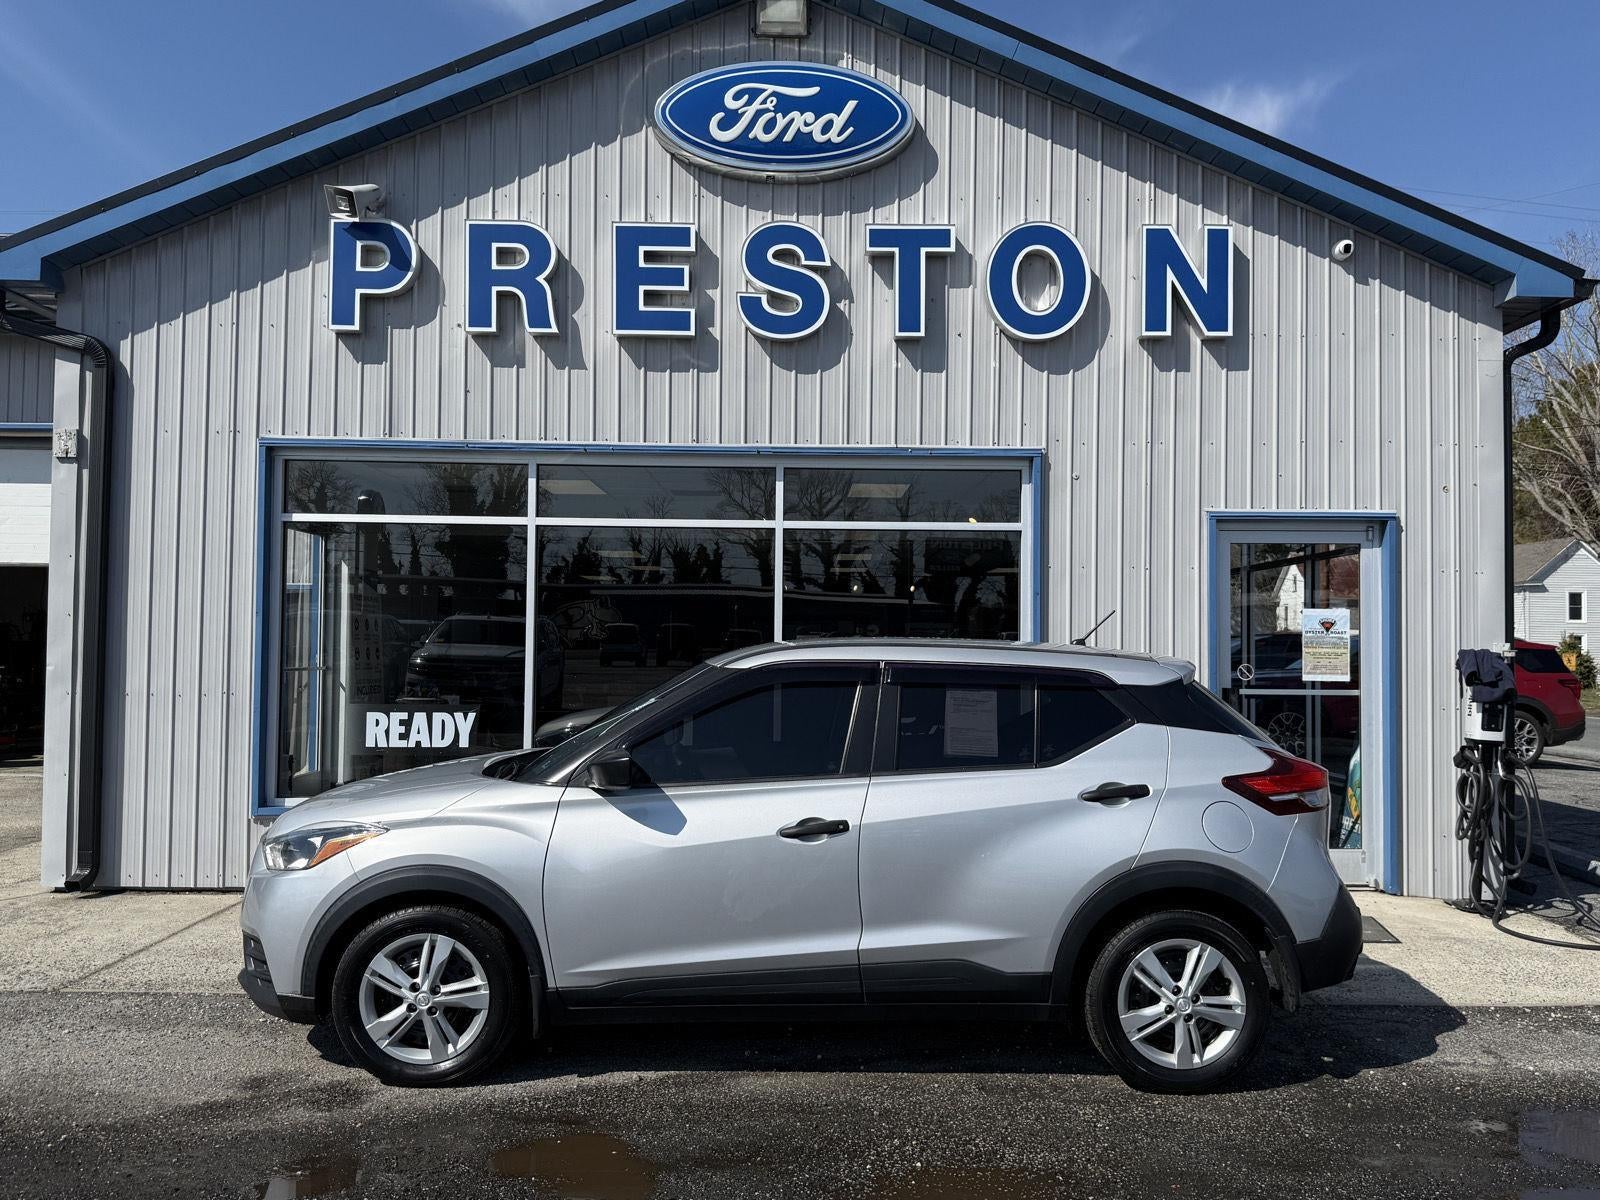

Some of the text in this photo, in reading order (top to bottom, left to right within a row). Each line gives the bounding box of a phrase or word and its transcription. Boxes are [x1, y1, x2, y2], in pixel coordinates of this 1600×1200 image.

[709, 82, 859, 144] Ford
[328, 219, 1234, 341] PRESTON
[365, 711, 477, 748] READY
